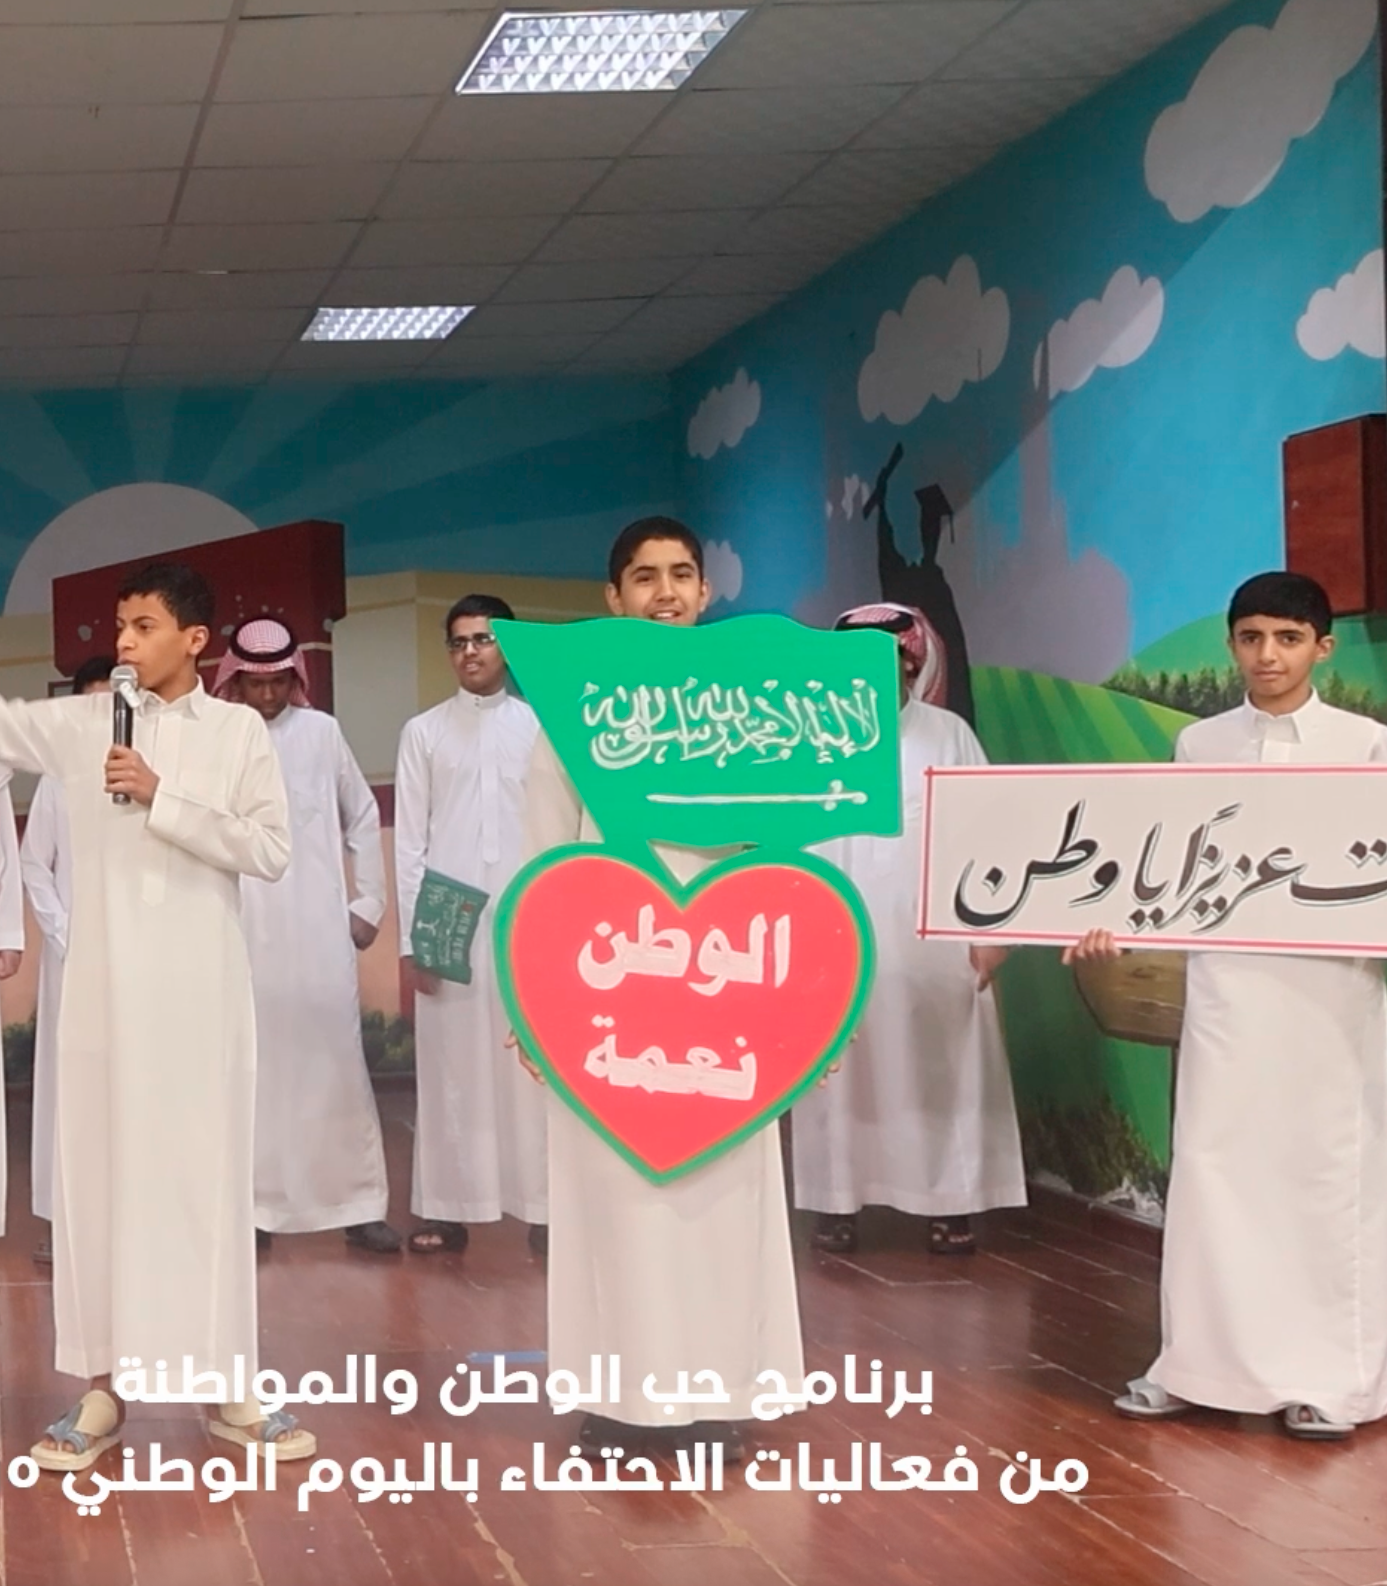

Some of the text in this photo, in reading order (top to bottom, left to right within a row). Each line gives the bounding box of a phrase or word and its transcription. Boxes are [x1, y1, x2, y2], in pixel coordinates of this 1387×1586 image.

[953, 800, 1120, 929] وطن
[1125, 822, 1169, 932] يا
[576, 903, 793, 997] الوطن
[583, 1014, 758, 1102] نعمة
